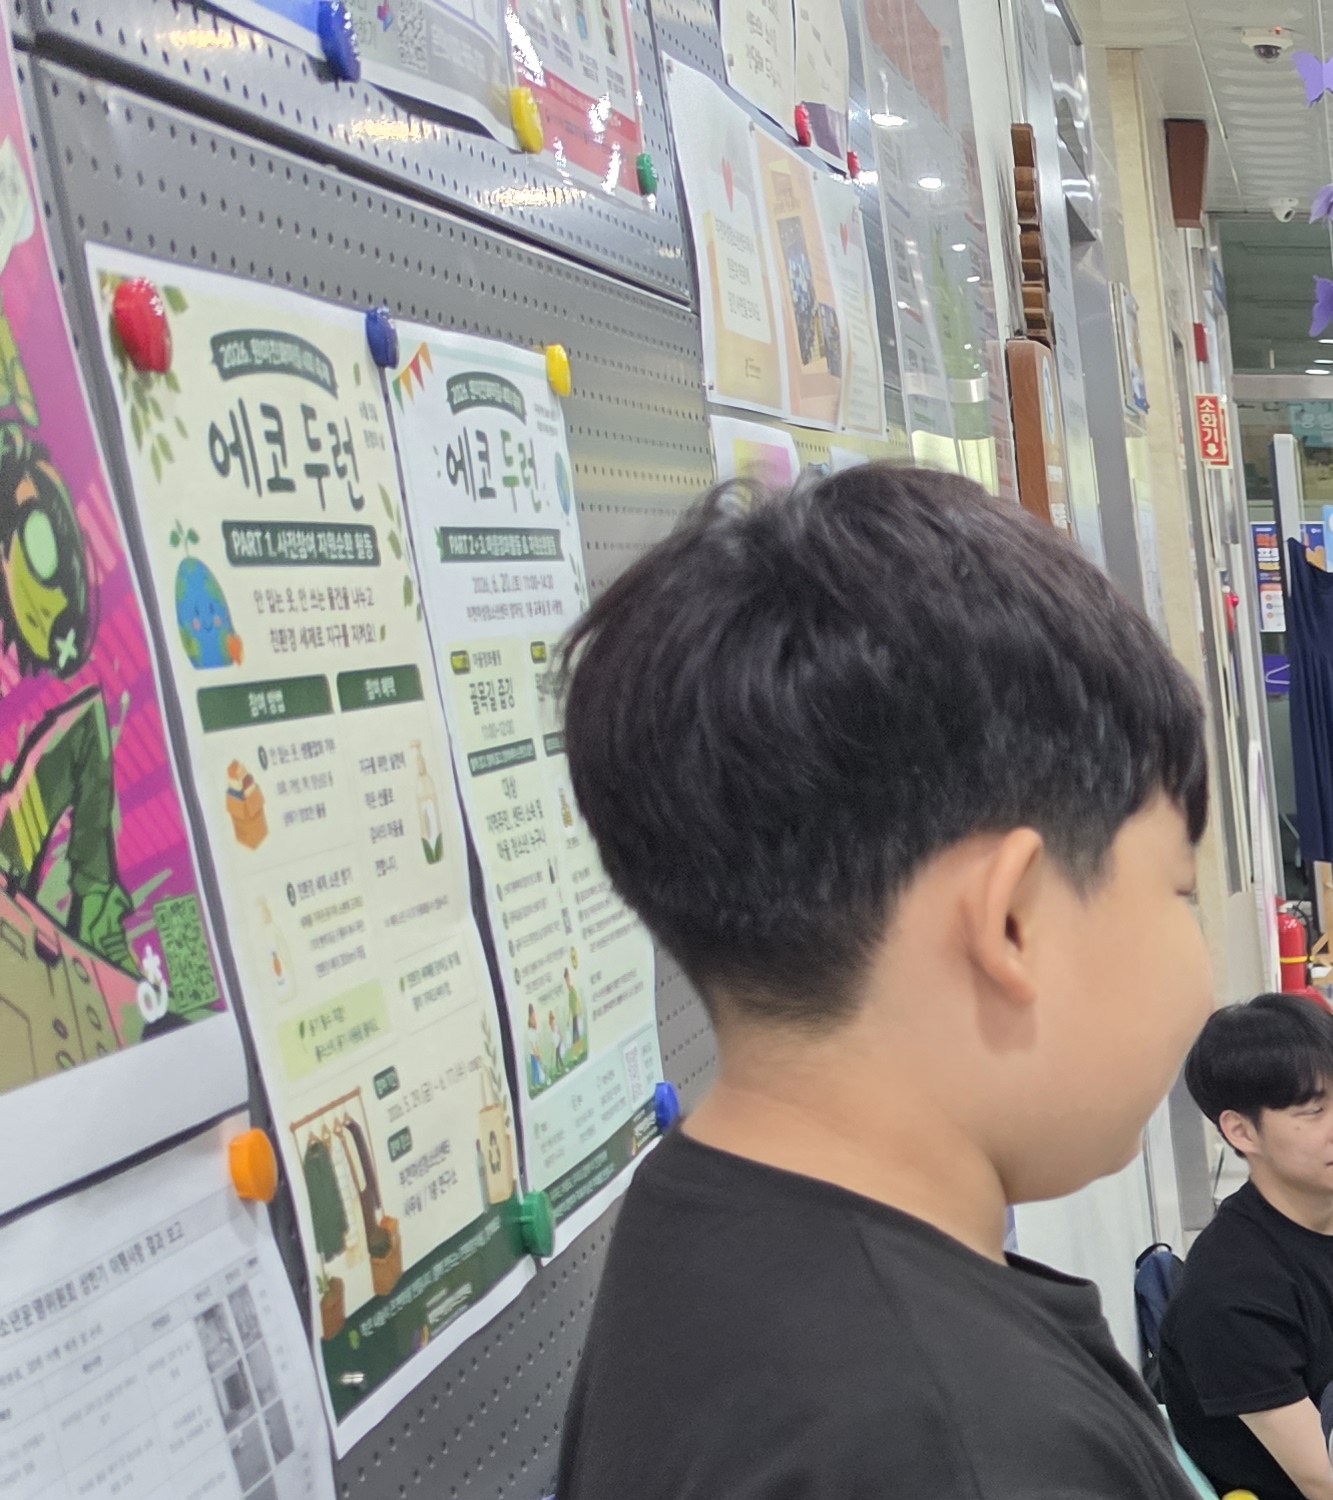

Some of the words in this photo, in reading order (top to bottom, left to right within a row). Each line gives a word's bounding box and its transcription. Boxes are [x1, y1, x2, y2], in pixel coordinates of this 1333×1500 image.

[1199, 398, 1219, 443] 소화기
[208, 397, 296, 498] 에코
[300, 402, 365, 512] 두런
[446, 425, 497, 503] 에코
[500, 428, 542, 514] 두런
[231, 529, 263, 557] PART
[355, 530, 374, 560] 활동
[253, 589, 264, 614] 안
[266, 589, 285, 613] 입는
[351, 587, 375, 609] 나누고
